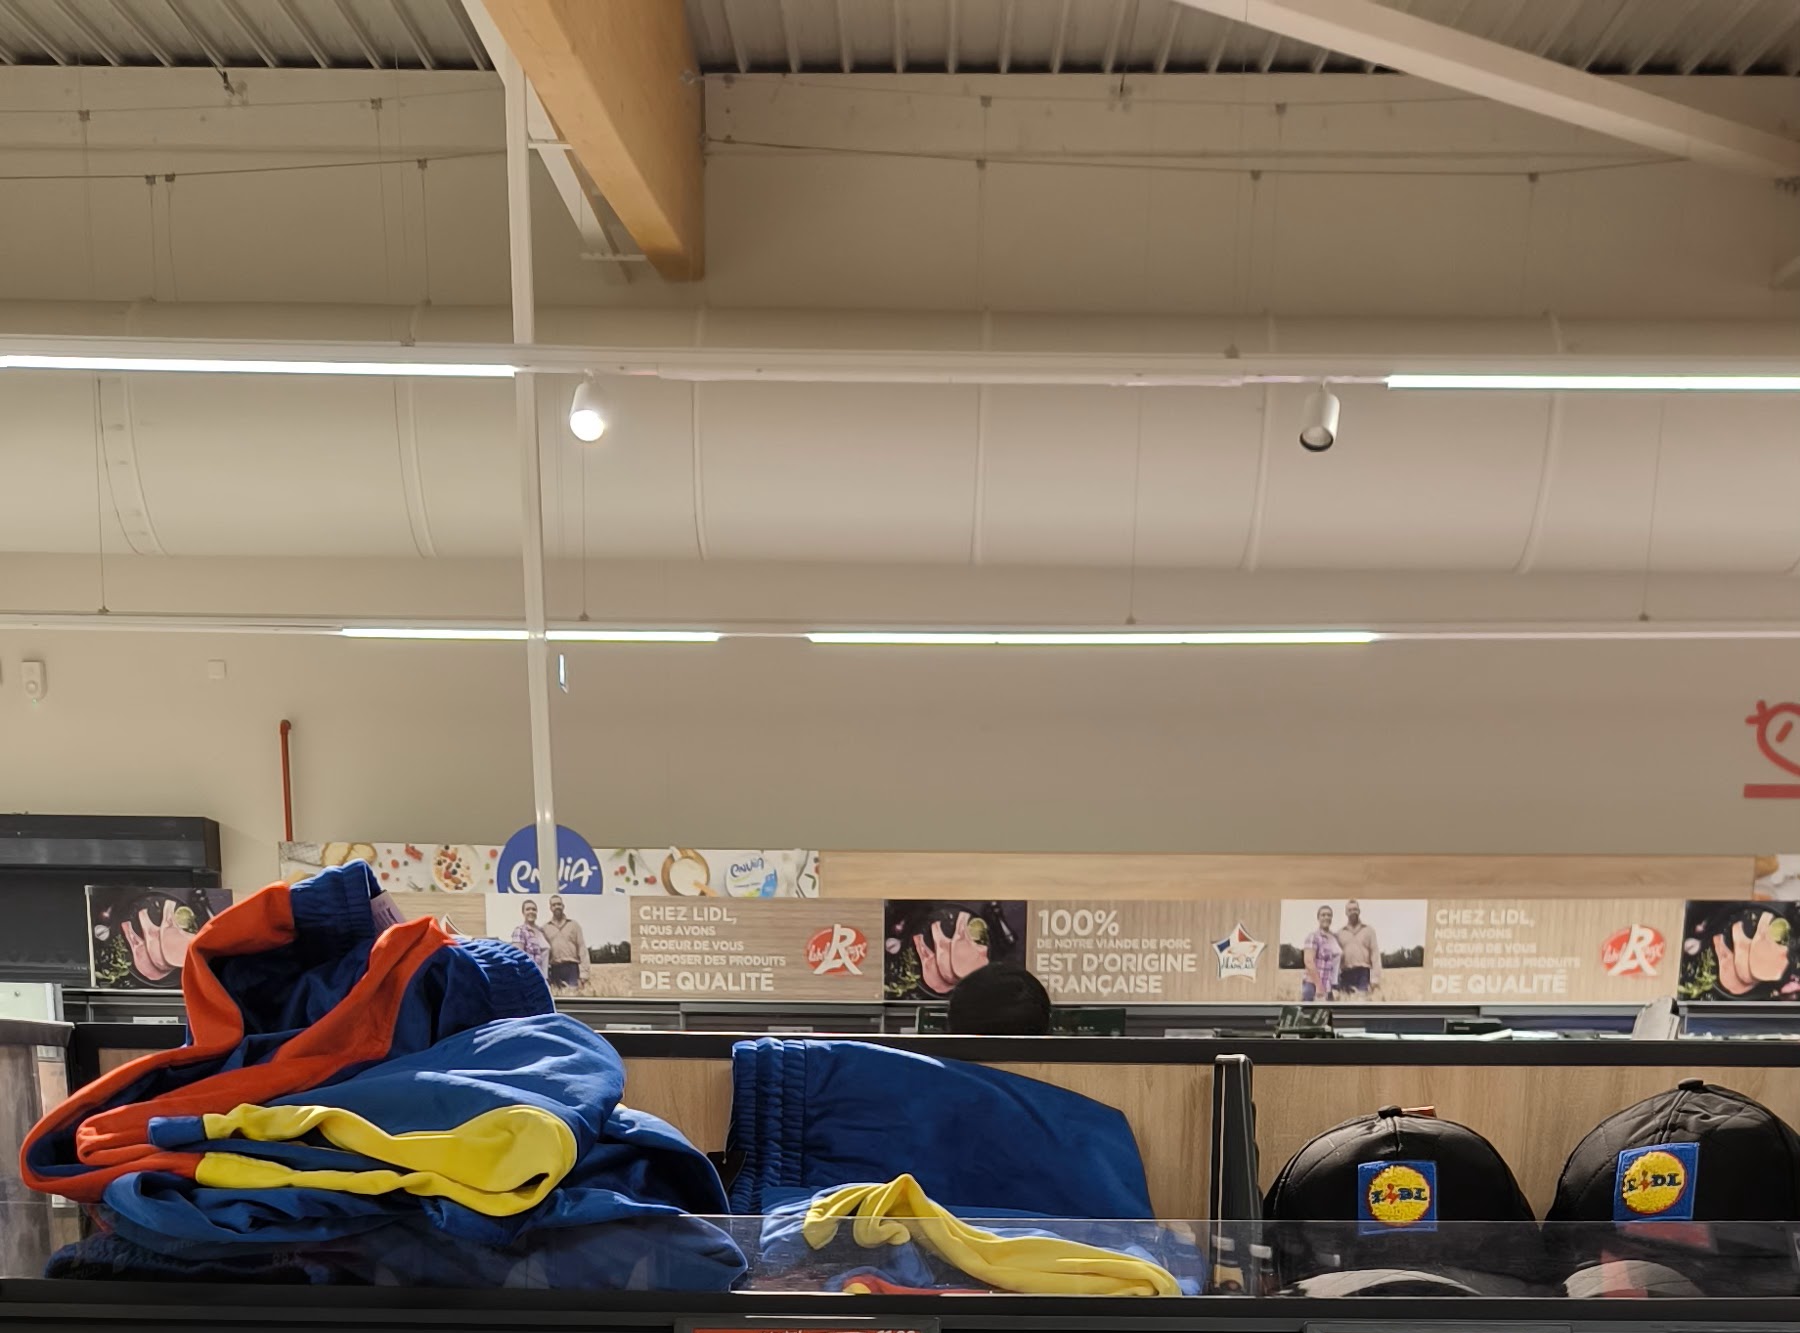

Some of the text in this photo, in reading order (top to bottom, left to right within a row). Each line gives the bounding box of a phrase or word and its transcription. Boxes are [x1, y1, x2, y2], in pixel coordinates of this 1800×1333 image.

[639, 905, 738, 926] CHEZ LIDL,
[1038, 909, 1120, 937] 100%
[1435, 909, 1536, 928] CHEZ LIDL,
[639, 925, 717, 937] NOUS AVONS
[1435, 928, 1513, 940] NOUS AVONS
[639, 937, 650, 951] À
[695, 941, 711, 951] DE
[711, 941, 745, 952] VOUS
[1037, 938, 1192, 950] DE NOTRE VIANDE DE PORC
[1485, 942, 1504, 954] DE
[1504, 942, 1538, 954] VOUS
[639, 954, 787, 968] PROPOSER DES PRODUITS
[1036, 953, 1077, 973] EST
[1082, 952, 1198, 973] D'ORIGINE
[1432, 957, 1581, 970] PROPOSER DES PRODUITS
[640, 966, 776, 993] DE QUALITÉ
[1430, 967, 1568, 995] DE QUALITÉ
[1624, 1171, 1682, 1194] LIDL
[1371, 1183, 1429, 1206] LIDL
